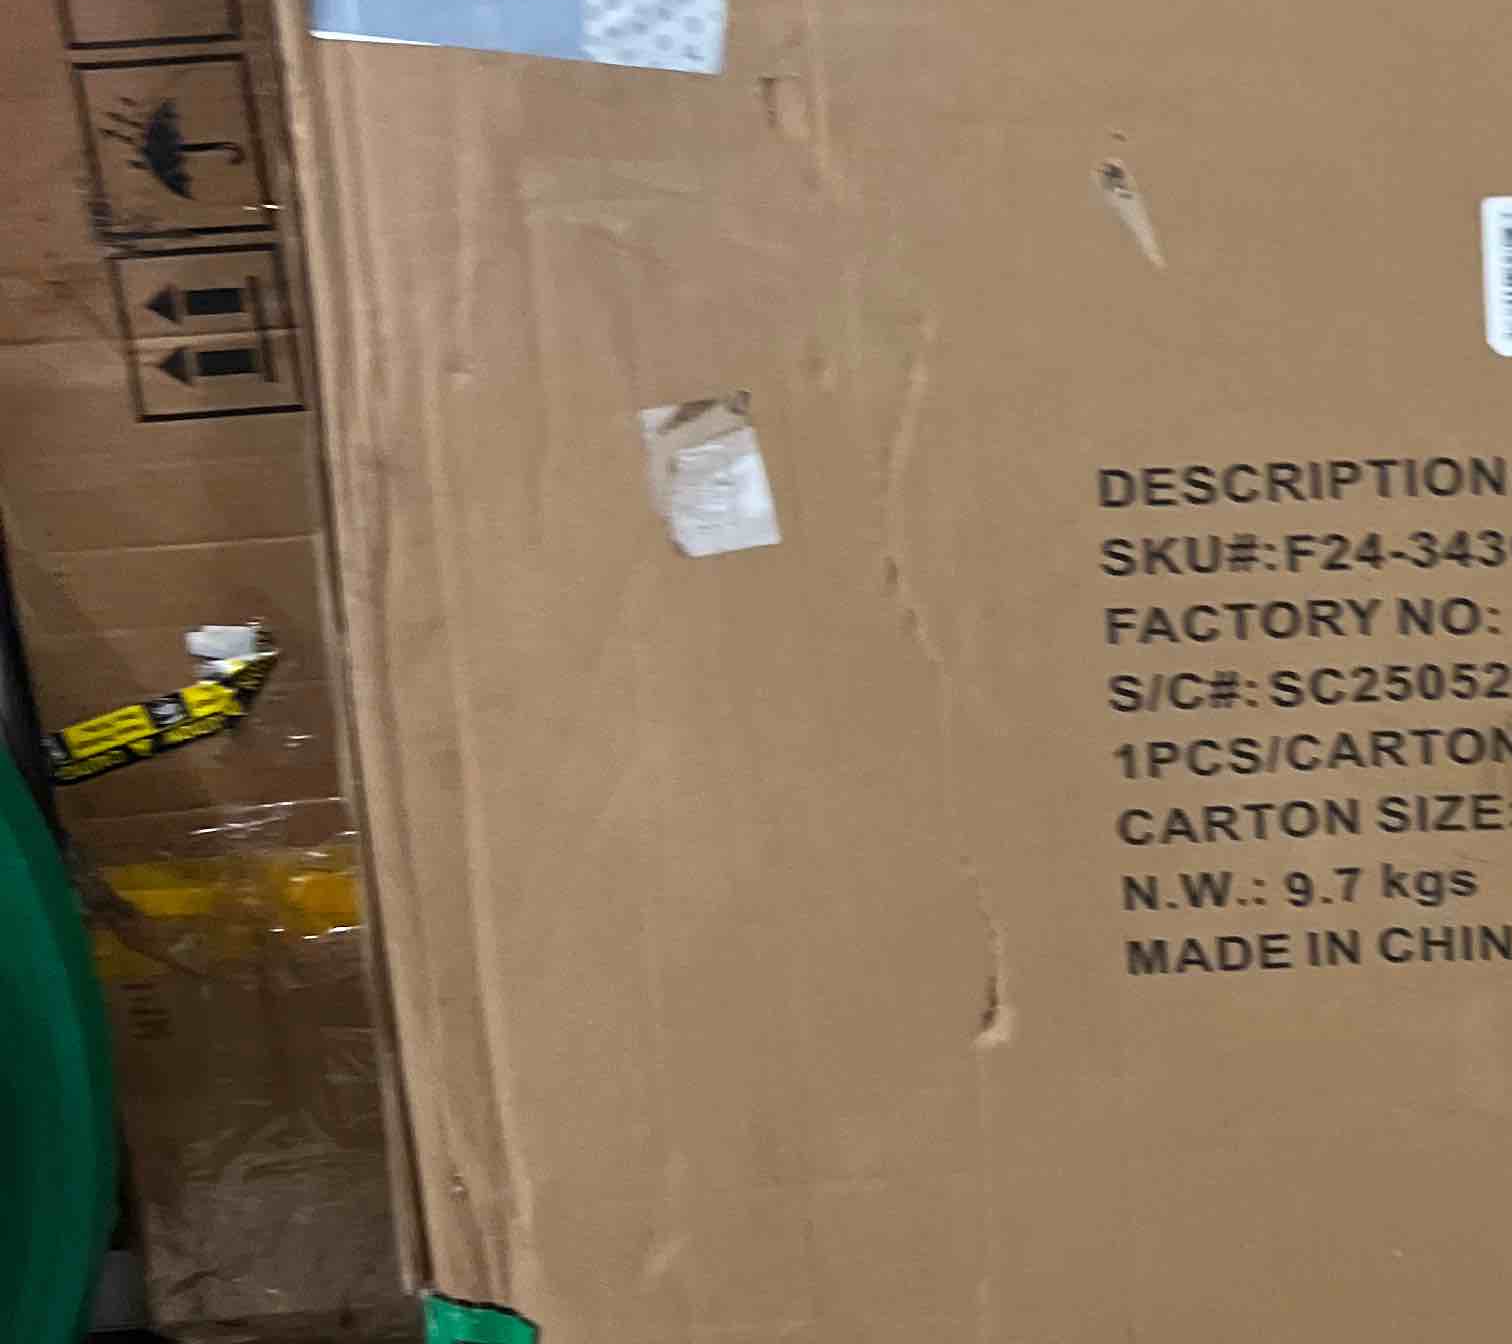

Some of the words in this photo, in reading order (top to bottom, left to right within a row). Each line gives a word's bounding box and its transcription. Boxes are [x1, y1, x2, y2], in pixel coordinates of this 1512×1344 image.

[1103, 597, 1384, 646] FACTORY
[1394, 595, 1503, 637] NO:
[1115, 798, 1361, 847] CARTON
[1122, 869, 1268, 912] N.W.:
[1283, 866, 1365, 909] 9.7
[1381, 862, 1480, 908] kgs
[1125, 931, 1293, 976] MADE
[1306, 928, 1363, 968] IN
